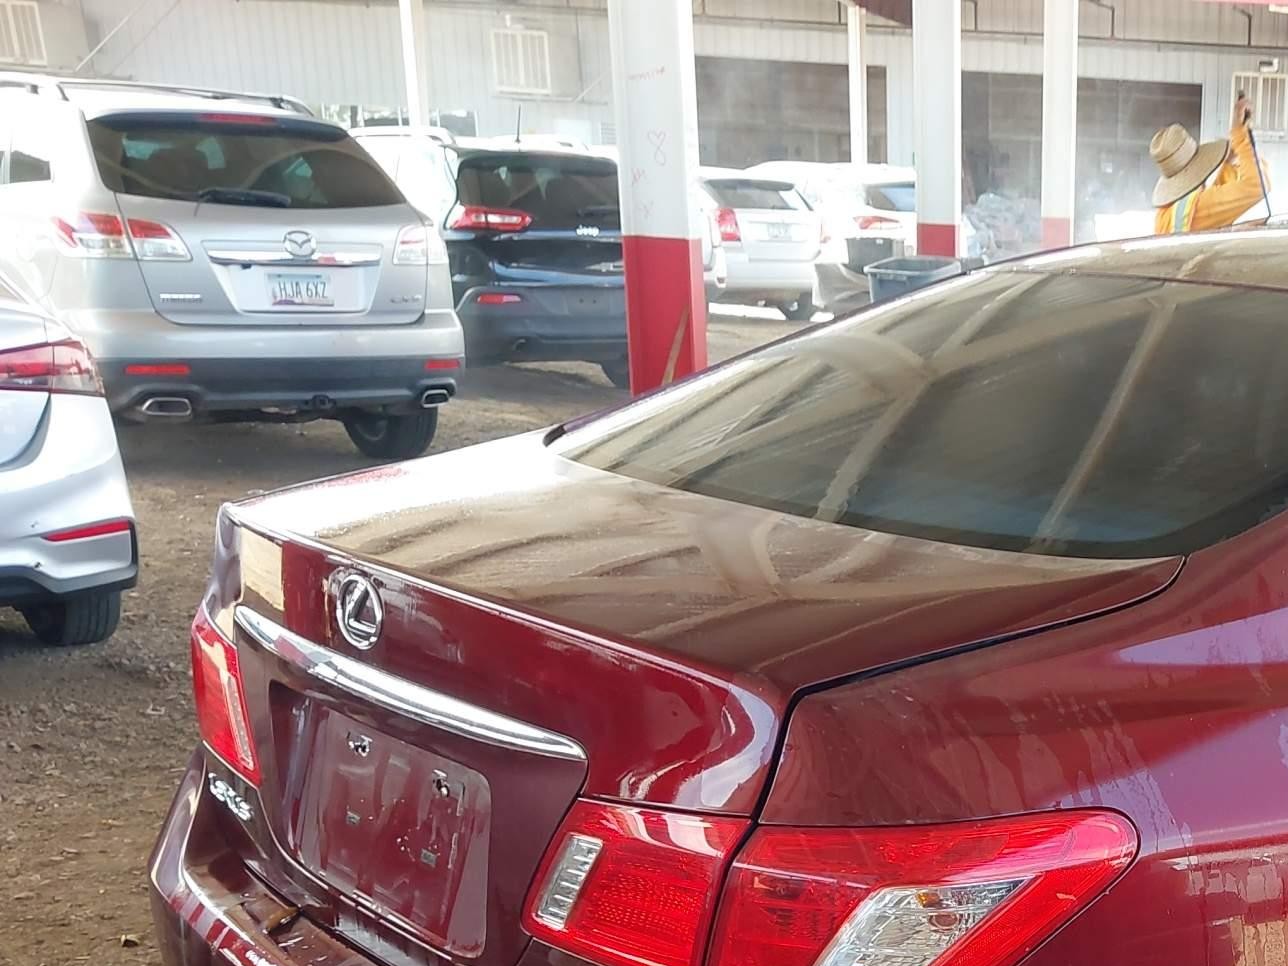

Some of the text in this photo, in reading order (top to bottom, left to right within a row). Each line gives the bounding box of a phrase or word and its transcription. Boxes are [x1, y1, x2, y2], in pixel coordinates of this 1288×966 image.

[576, 224, 600, 237] Jeep
[278, 281, 328, 298] HJA 6XZ
